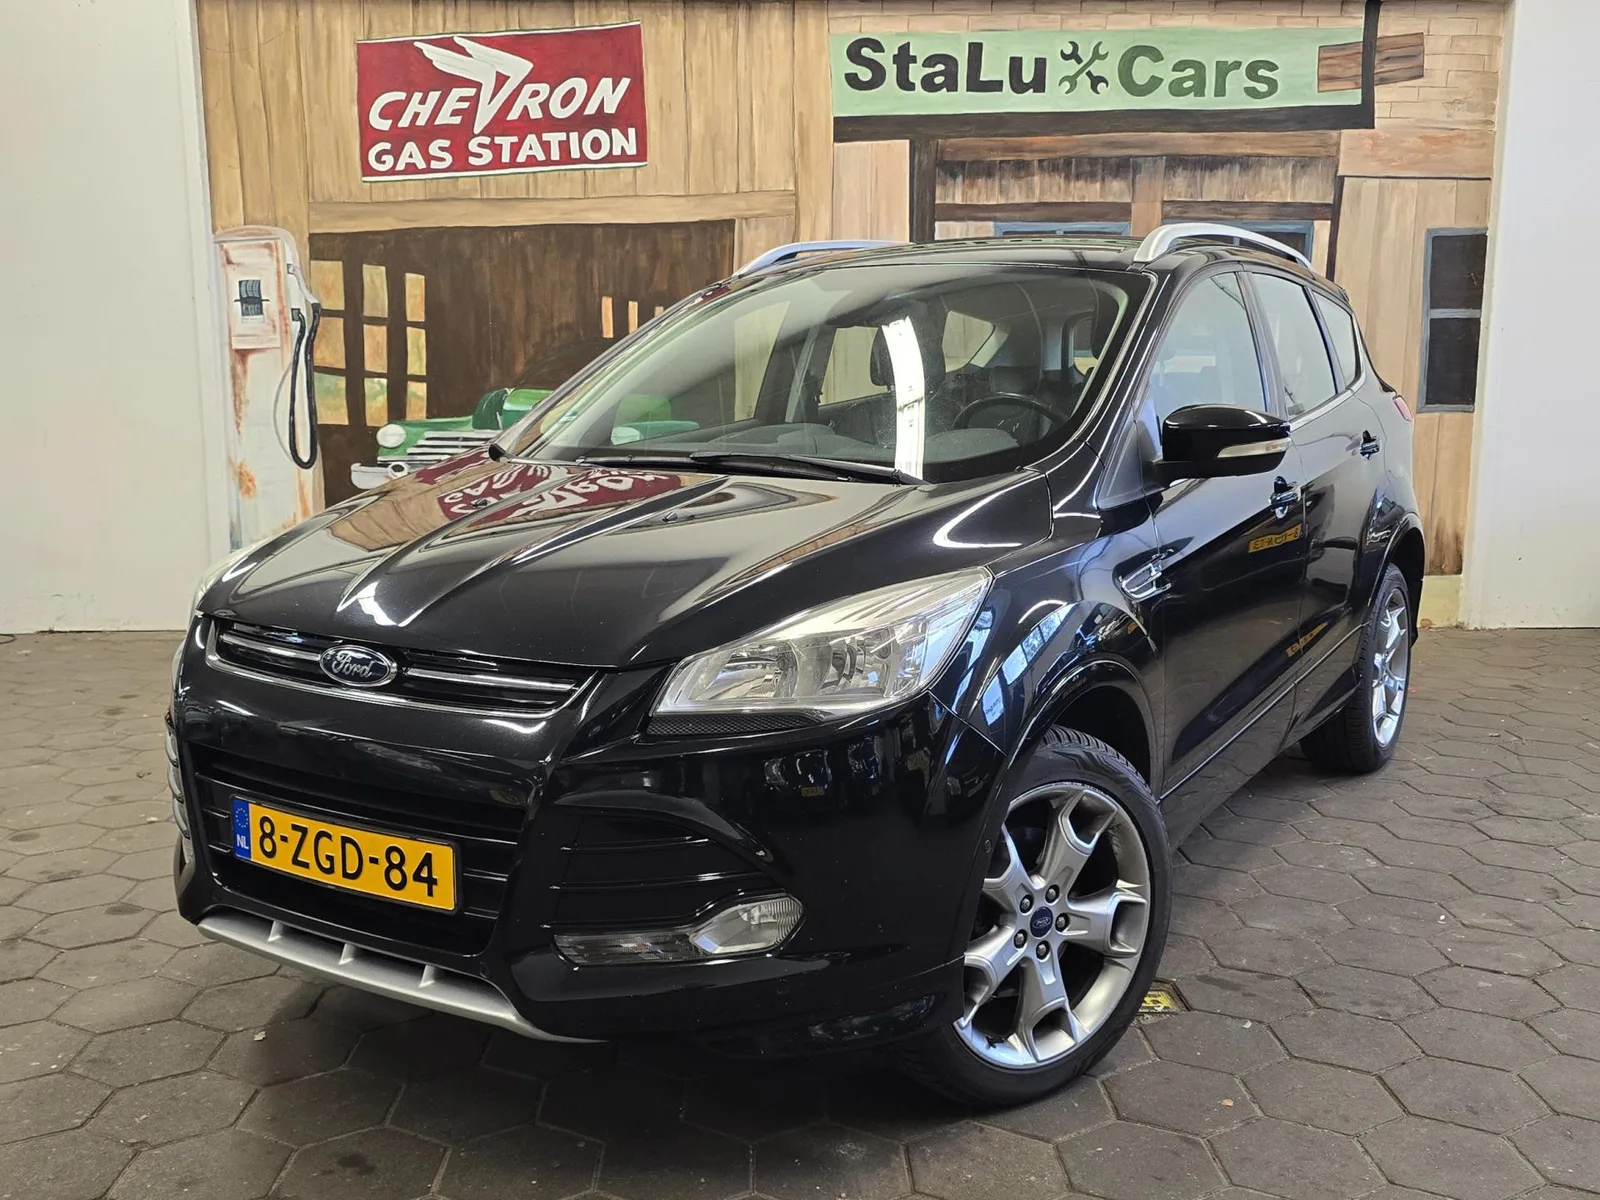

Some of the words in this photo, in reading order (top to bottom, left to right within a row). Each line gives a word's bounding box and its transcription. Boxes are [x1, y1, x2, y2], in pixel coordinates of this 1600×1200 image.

[844, 37, 1047, 93] StaLu
[1117, 44, 1280, 100] Cars
[368, 76, 631, 135] CHEVRON
[367, 141, 453, 172] GAS
[468, 127, 637, 166] STATION
[331, 650, 373, 678] Ford
[235, 834, 250, 851] NL
[258, 815, 438, 898] 8-ZGD-84
